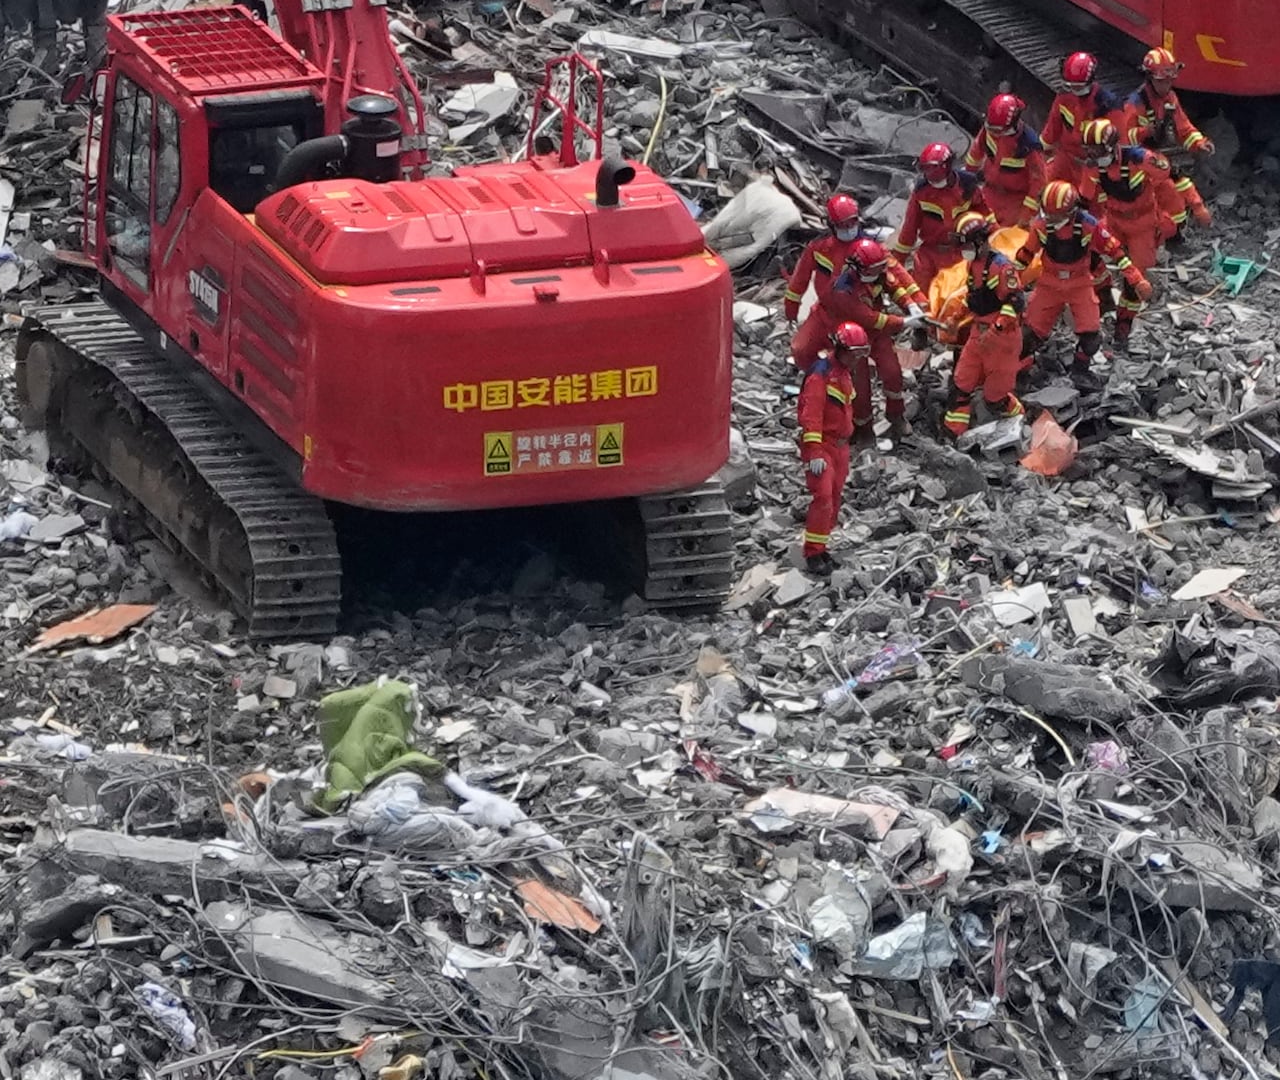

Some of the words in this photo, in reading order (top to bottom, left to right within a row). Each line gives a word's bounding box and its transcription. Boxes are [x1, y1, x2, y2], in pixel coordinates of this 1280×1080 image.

[443, 365, 658, 413] 中国安能集团
